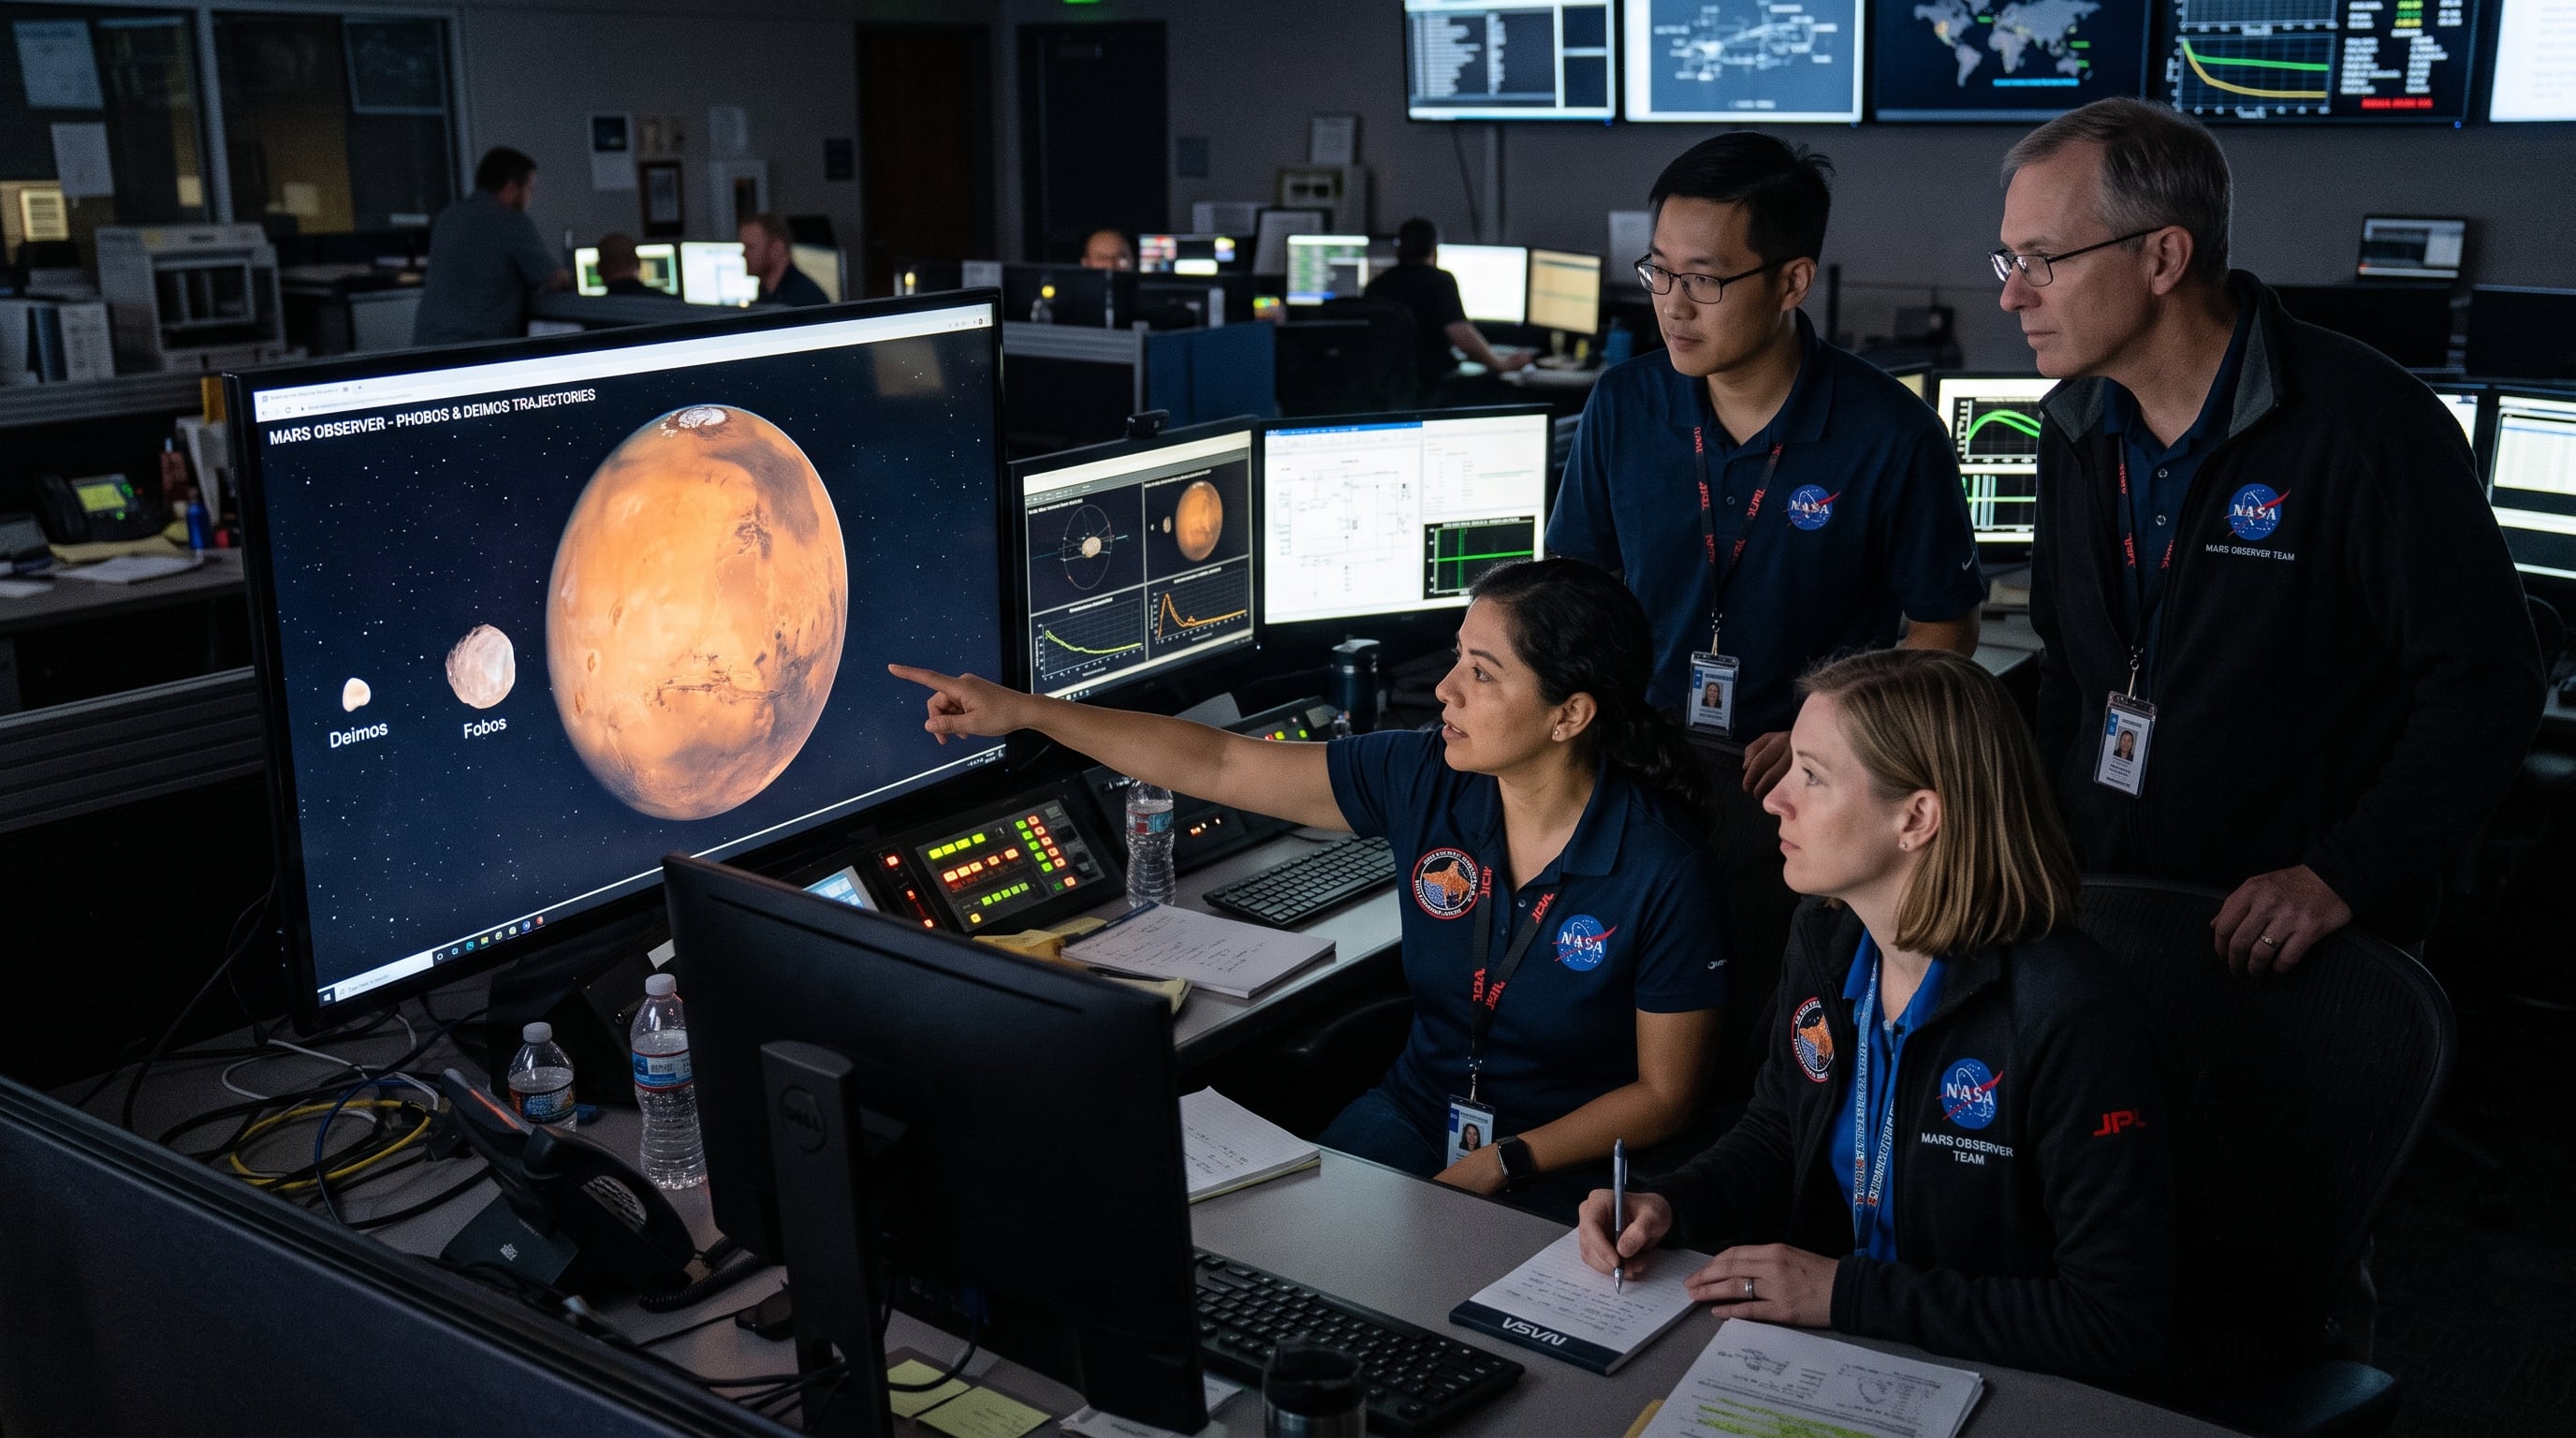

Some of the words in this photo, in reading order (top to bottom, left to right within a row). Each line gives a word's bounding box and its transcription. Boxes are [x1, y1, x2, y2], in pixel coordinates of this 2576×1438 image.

[270, 426, 312, 446] MARS
[314, 417, 387, 439] OBSERVER
[396, 407, 450, 428] PHOBOS
[452, 406, 461, 419] &
[463, 400, 510, 418] DEIMOS
[511, 388, 596, 412] TRAJECTORIES
[1791, 500, 1829, 514] NASA
[2233, 504, 2276, 521] NASA
[2205, 544, 2229, 553] MARS
[2231, 547, 2271, 559] OBSERVER
[2273, 550, 2295, 561] TEAM
[329, 723, 388, 748] Deimos
[463, 718, 507, 740] Fobos
[1561, 931, 1603, 954] NASA
[1946, 1082, 1995, 1107] NASA
[1922, 1132, 1954, 1147] MARS
[1955, 1137, 2013, 1157] OBSERVER
[1953, 1151, 1985, 1166] TEAM
[1501, 1317, 1568, 1346] NASA
